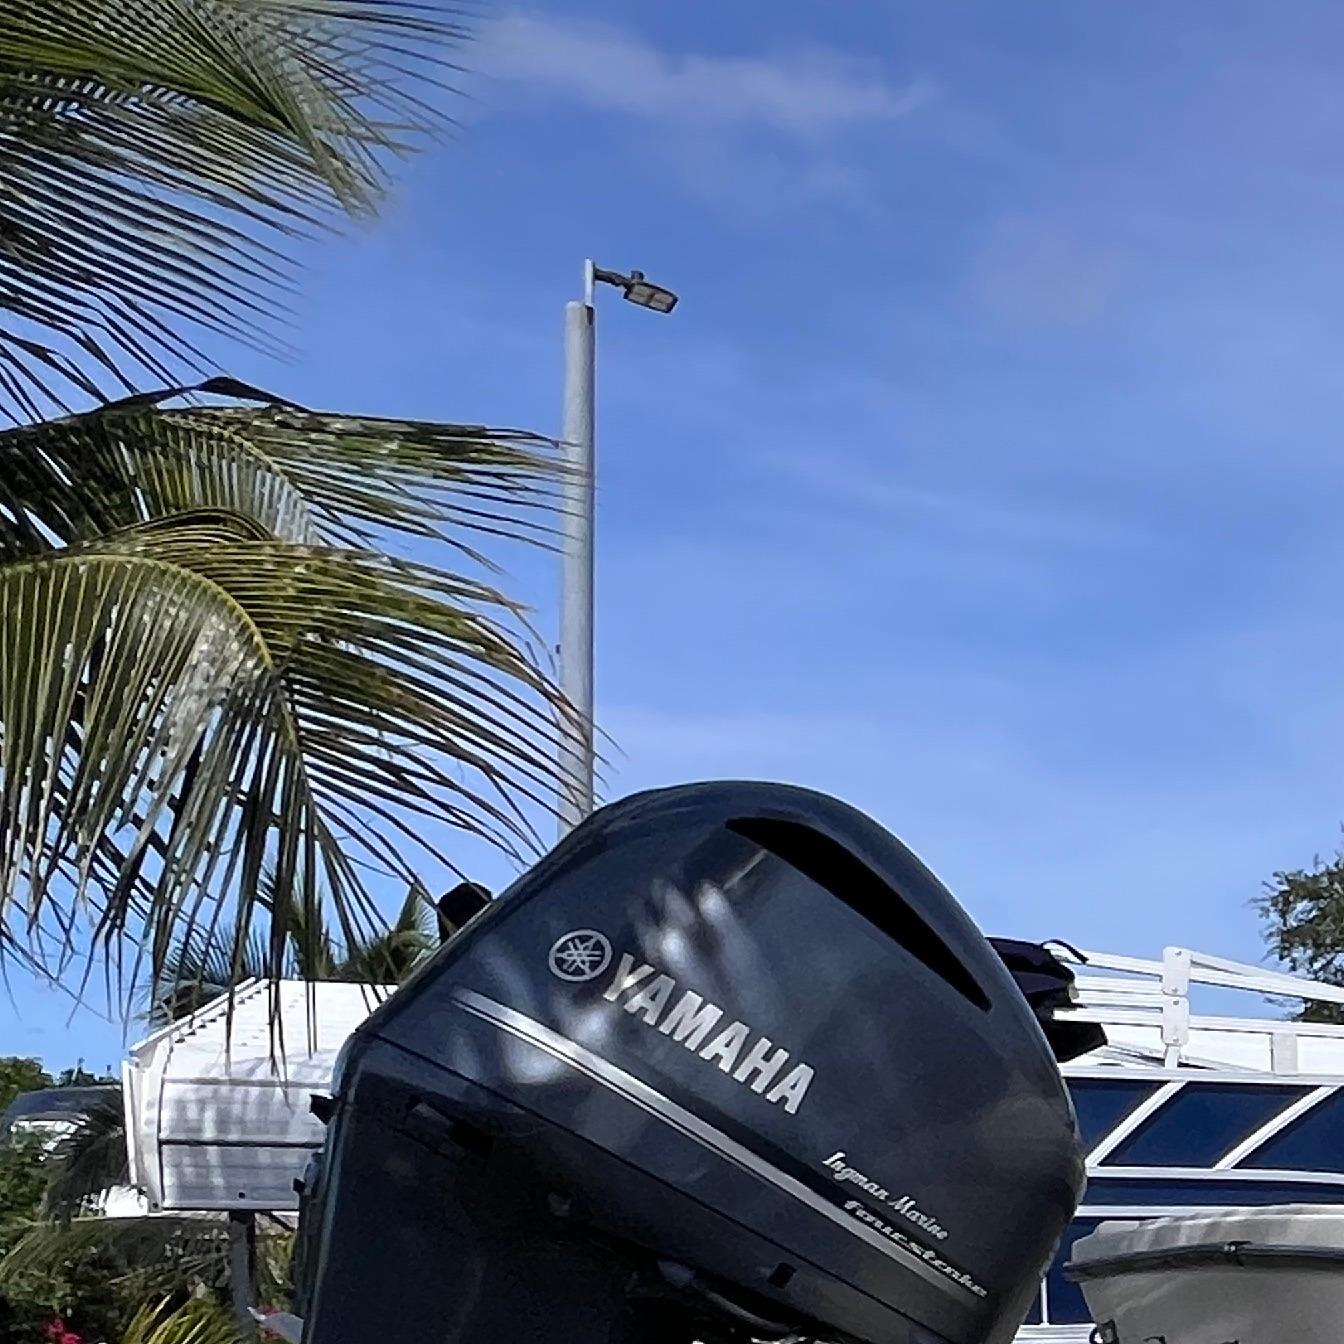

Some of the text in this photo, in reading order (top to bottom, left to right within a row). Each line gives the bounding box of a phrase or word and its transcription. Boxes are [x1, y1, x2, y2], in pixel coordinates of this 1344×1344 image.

[603, 953, 815, 1115] YAMAHA
[822, 1152, 948, 1240] Ingman Marine
